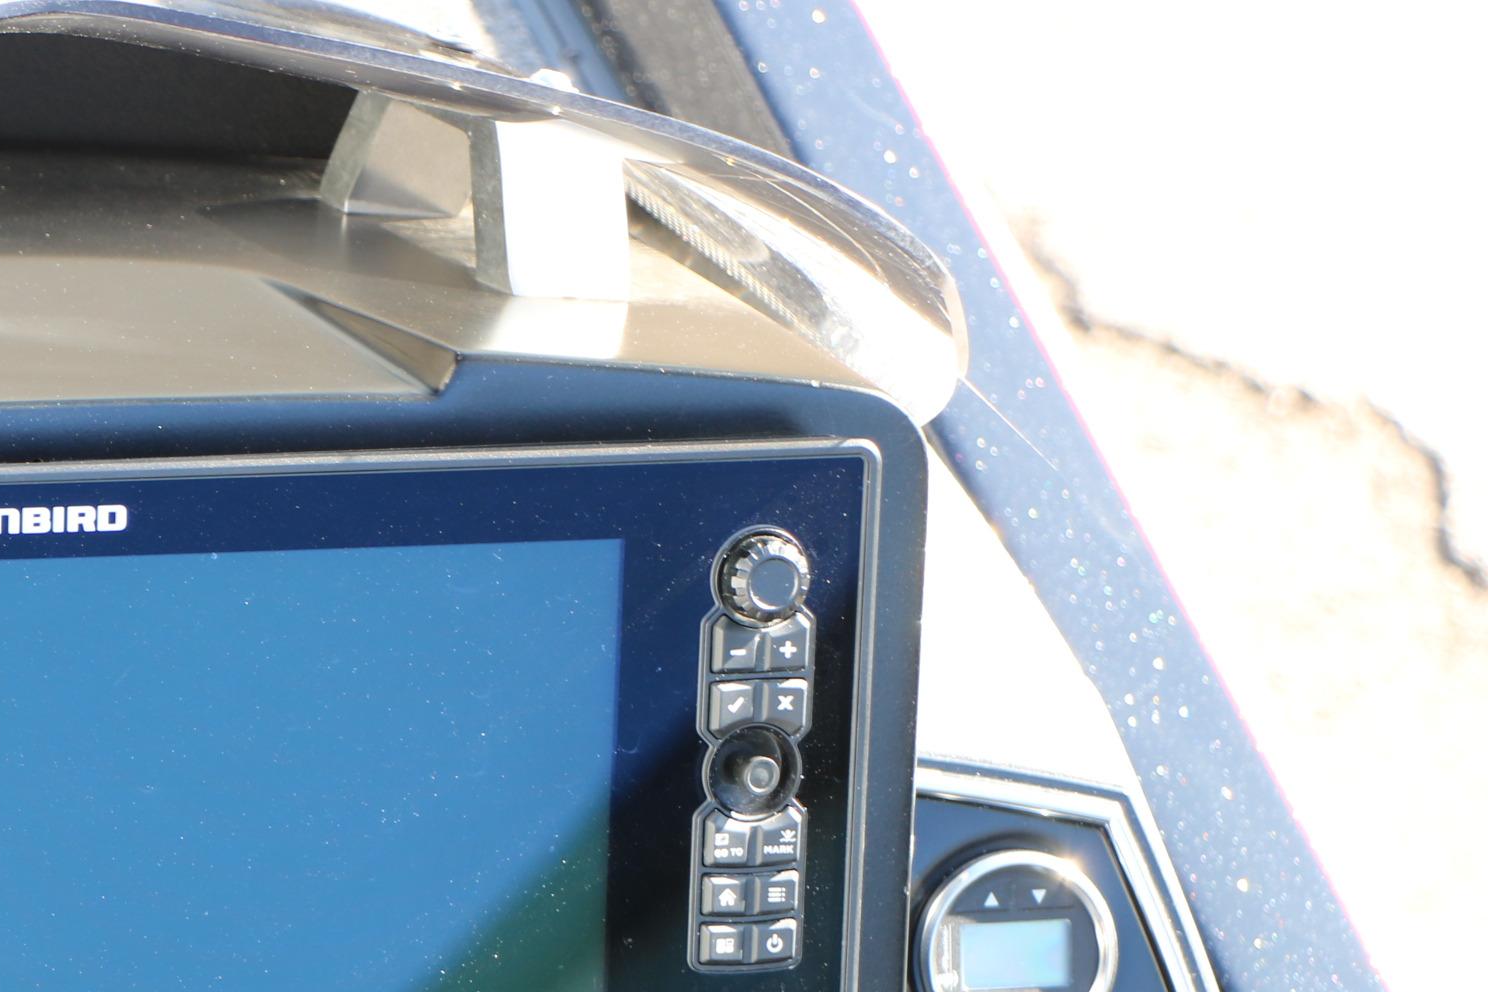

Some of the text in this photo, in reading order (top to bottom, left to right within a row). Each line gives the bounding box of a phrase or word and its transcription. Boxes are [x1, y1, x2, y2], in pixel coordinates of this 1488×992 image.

[714, 847, 744, 858] GO TO
[763, 845, 794, 855] MARK
